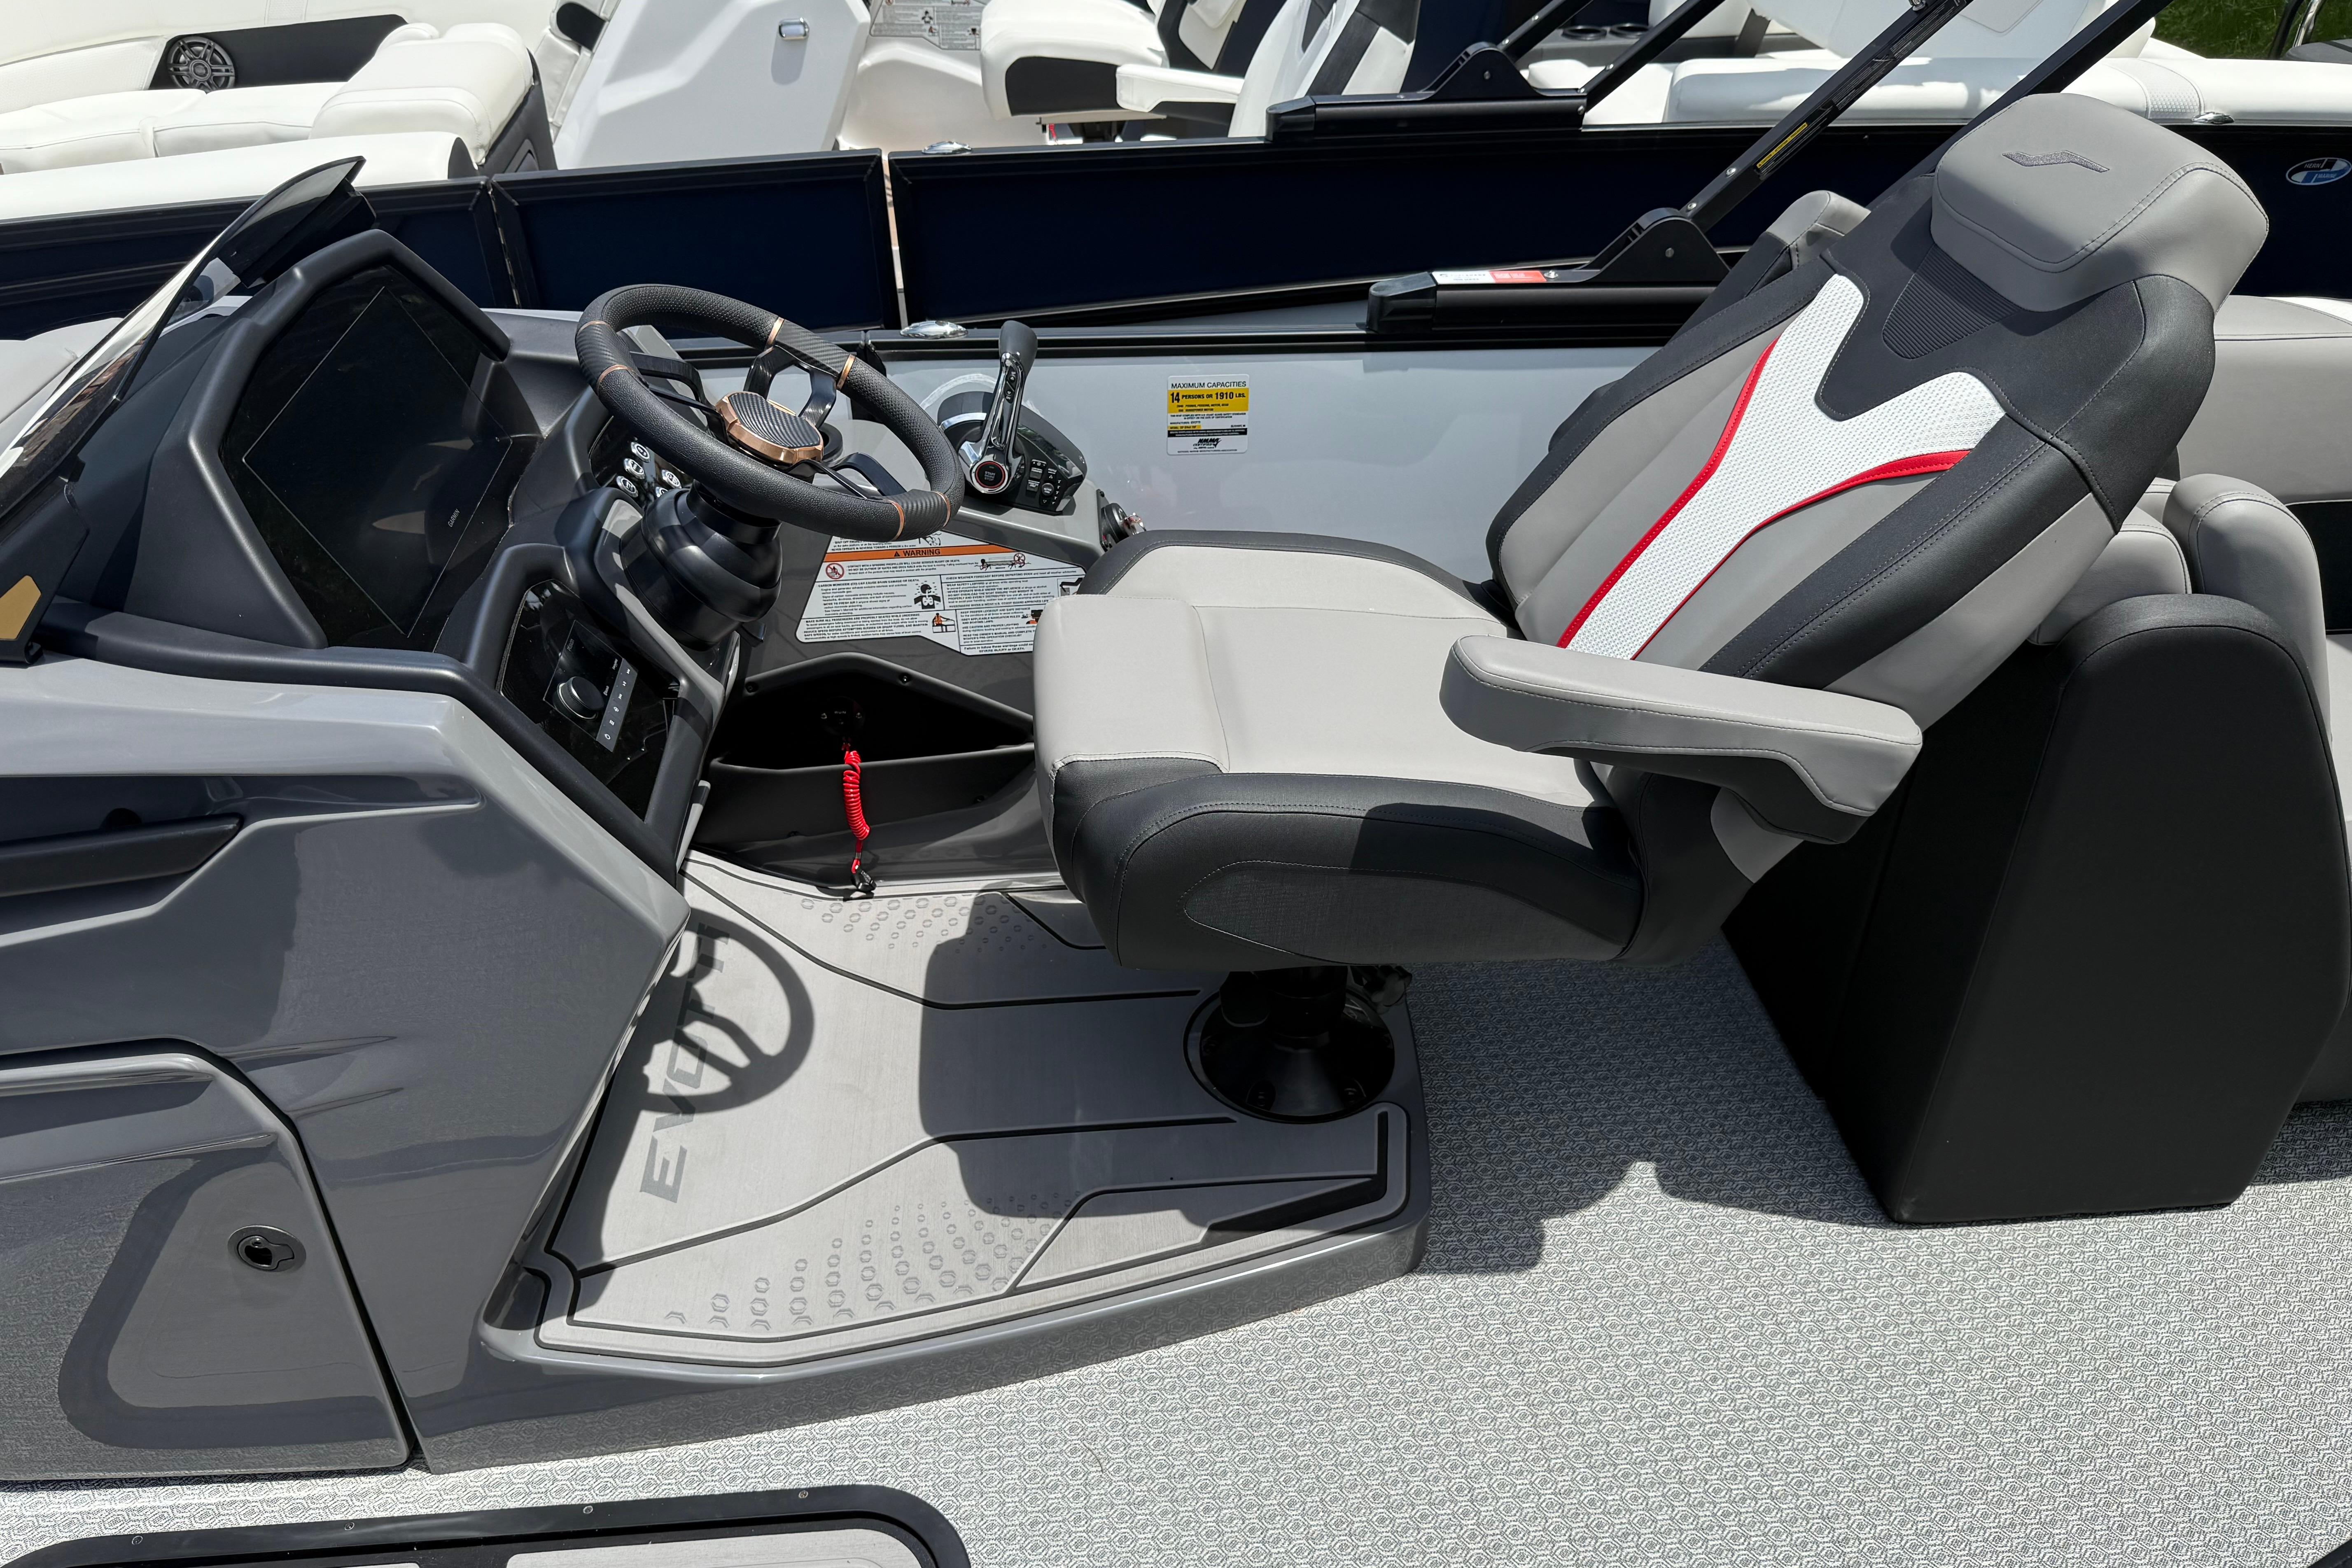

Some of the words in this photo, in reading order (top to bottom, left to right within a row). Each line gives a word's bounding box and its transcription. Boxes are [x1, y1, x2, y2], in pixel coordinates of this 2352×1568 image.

[1170, 392, 1180, 403] 14
[448, 508, 460, 527] GARMIN
[903, 548, 940, 557] WARNING
[640, 923, 730, 1204] EVOTTI
